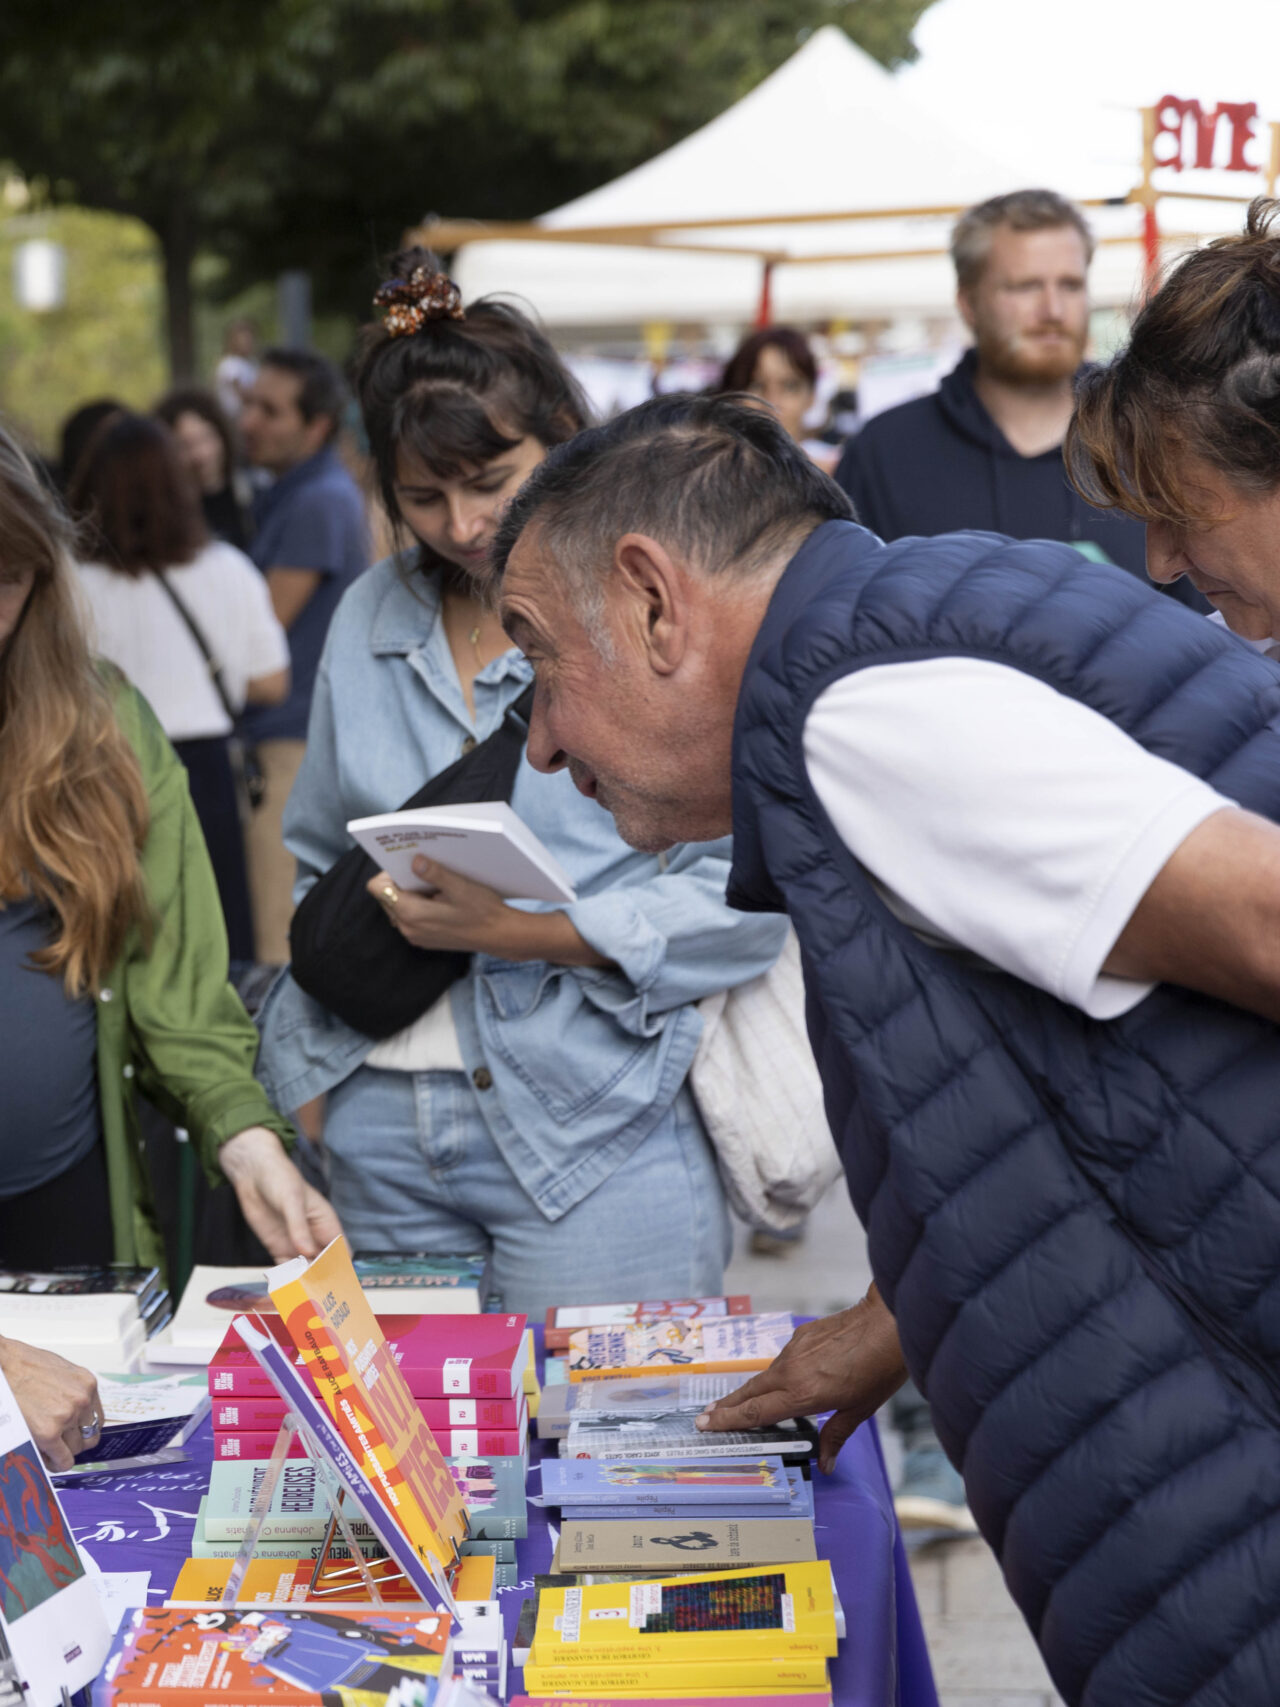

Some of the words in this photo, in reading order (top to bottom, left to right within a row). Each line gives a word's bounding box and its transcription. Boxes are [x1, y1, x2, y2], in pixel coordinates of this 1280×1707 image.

[303, 1329, 330, 1371] RAYBAUD
[324, 1369, 343, 1396] ALICE
[338, 1397, 364, 1435] AMITIÉS
[280, 1466, 315, 1512] HEUREUSES
[274, 1526, 313, 1534] Johanna
[261, 1550, 301, 1558] Johanna
[595, 1609, 620, 1617] 3
[788, 1646, 818, 1654] Champs
[776, 1674, 806, 1682] Champs
